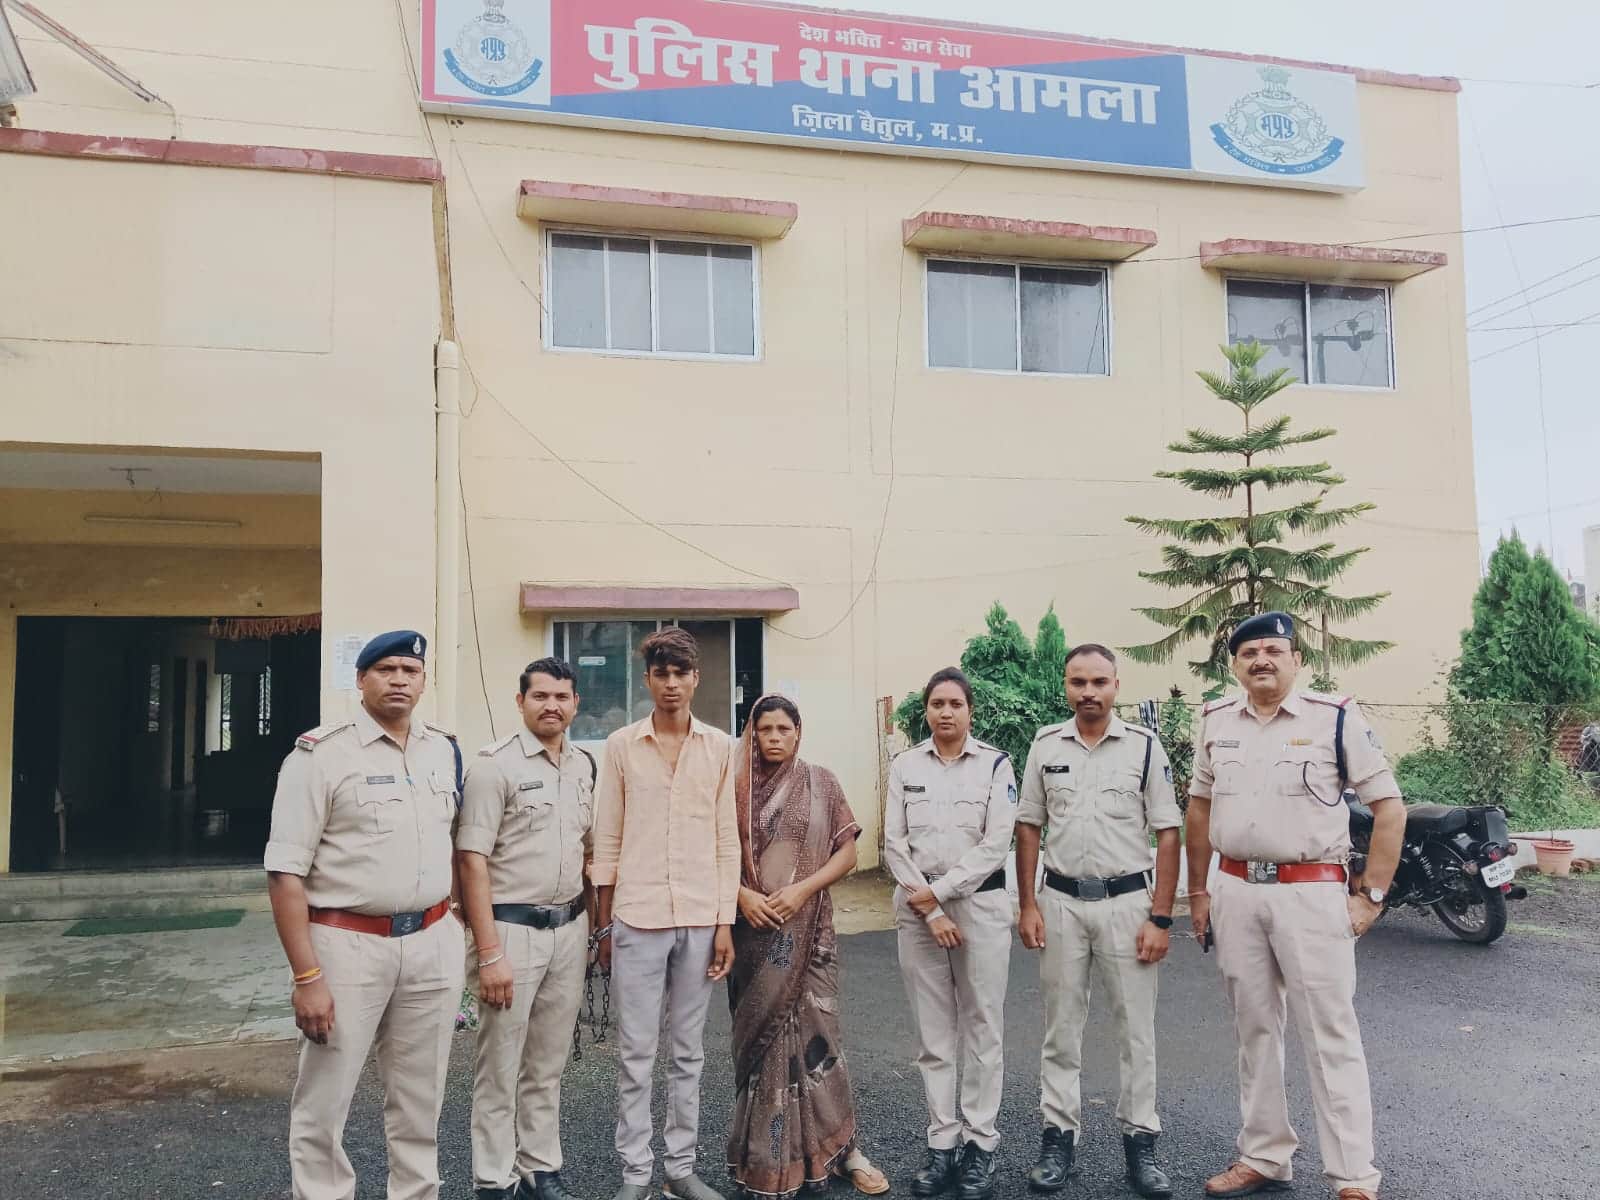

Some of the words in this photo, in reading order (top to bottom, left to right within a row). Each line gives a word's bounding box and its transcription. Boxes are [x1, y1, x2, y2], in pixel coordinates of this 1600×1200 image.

[584, 17, 780, 91] पुलिस
[799, 48, 942, 104] थाना
[959, 65, 1161, 125] आमला
[799, 23, 828, 43] देश
[902, 38, 932, 53] जन
[938, 38, 972, 58] सेवा
